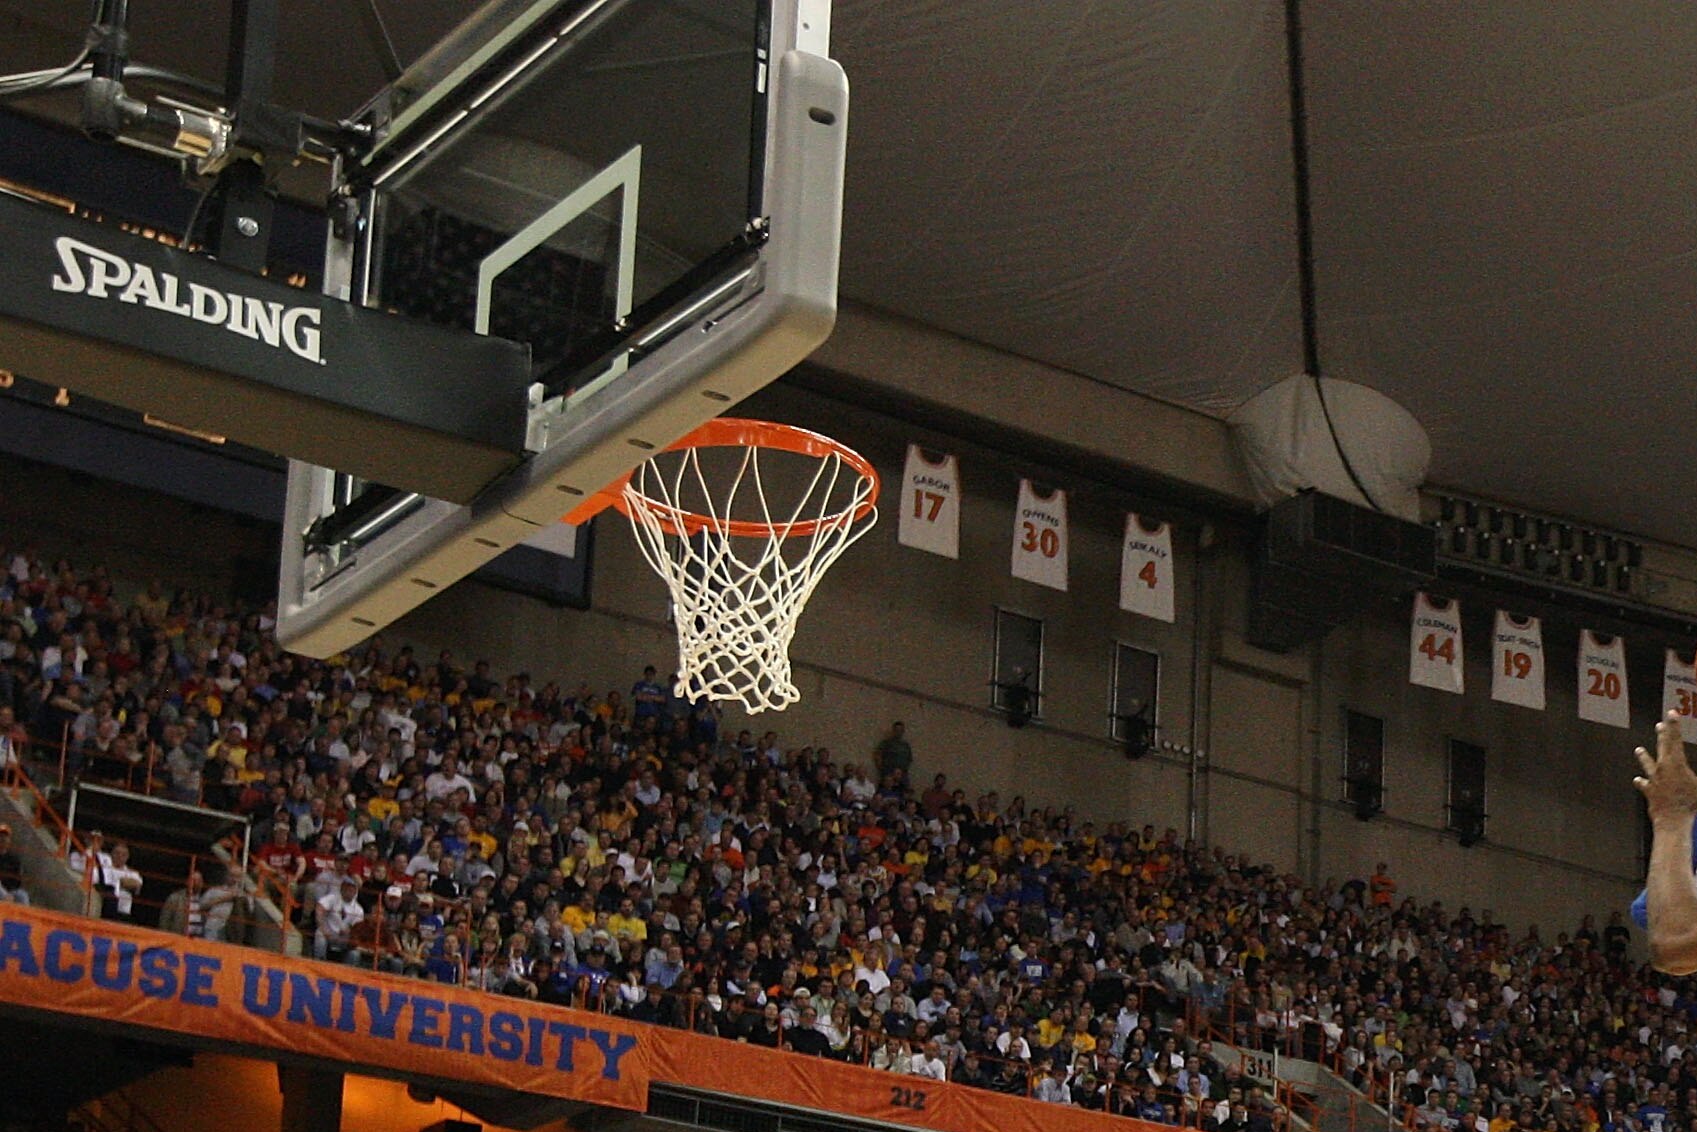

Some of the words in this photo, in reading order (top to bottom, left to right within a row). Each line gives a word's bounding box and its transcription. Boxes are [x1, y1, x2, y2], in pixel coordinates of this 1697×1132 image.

[53, 236, 322, 365] SPALDING
[914, 490, 945, 522] 17
[1021, 522, 1060, 558] 30
[1138, 561, 1158, 589] 4
[1419, 633, 1455, 665] 44
[1504, 650, 1531, 680] 19
[1587, 668, 1620, 700] 20
[242, 964, 636, 1080] UNIVERSITY
[1247, 1055, 1272, 1079] 311
[890, 1085, 926, 1111] 212
